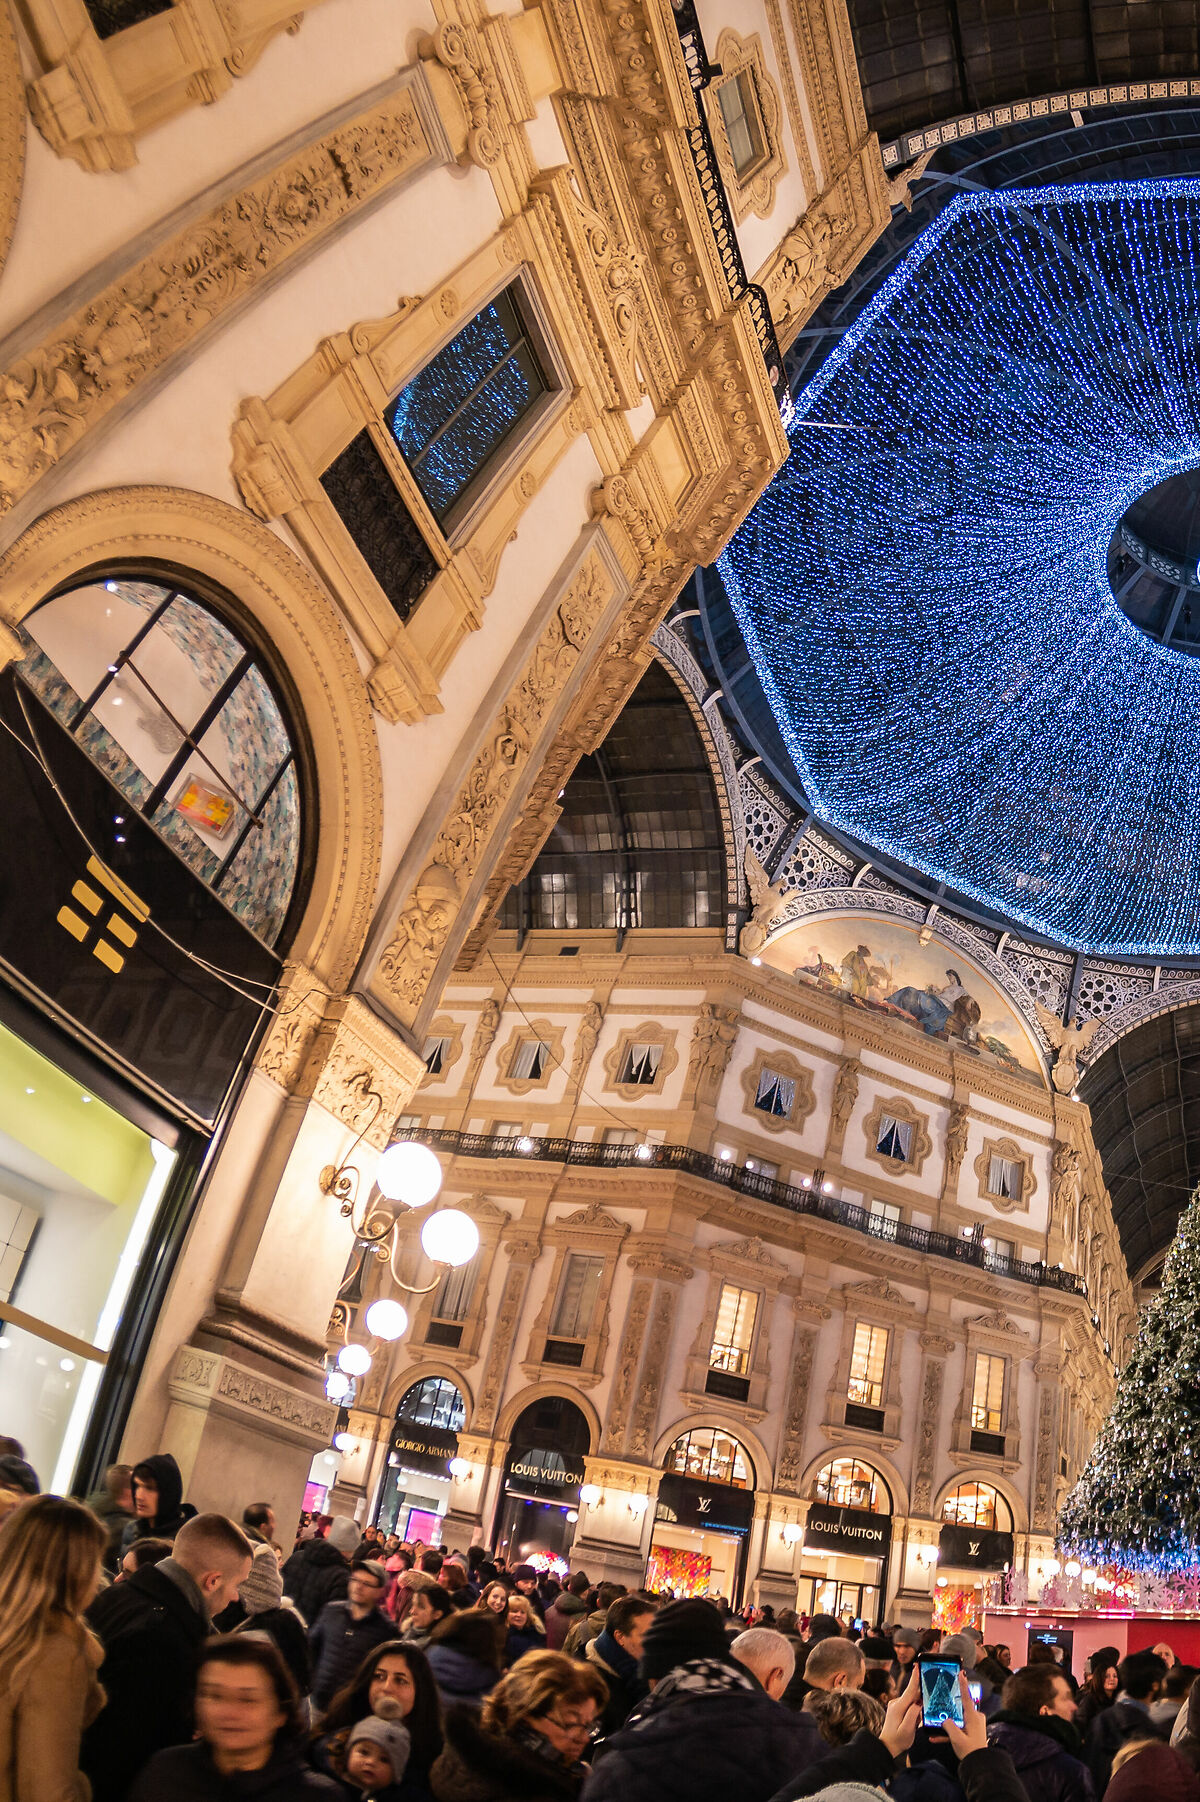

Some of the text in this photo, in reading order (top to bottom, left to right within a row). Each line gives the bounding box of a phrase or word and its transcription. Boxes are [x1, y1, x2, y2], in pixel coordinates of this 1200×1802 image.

[395, 1438, 456, 1459] GIORGIO ARMANI
[510, 1462, 583, 1485] LOUIS VUITTON
[810, 1520, 883, 1542] LOUIS VUITTON
